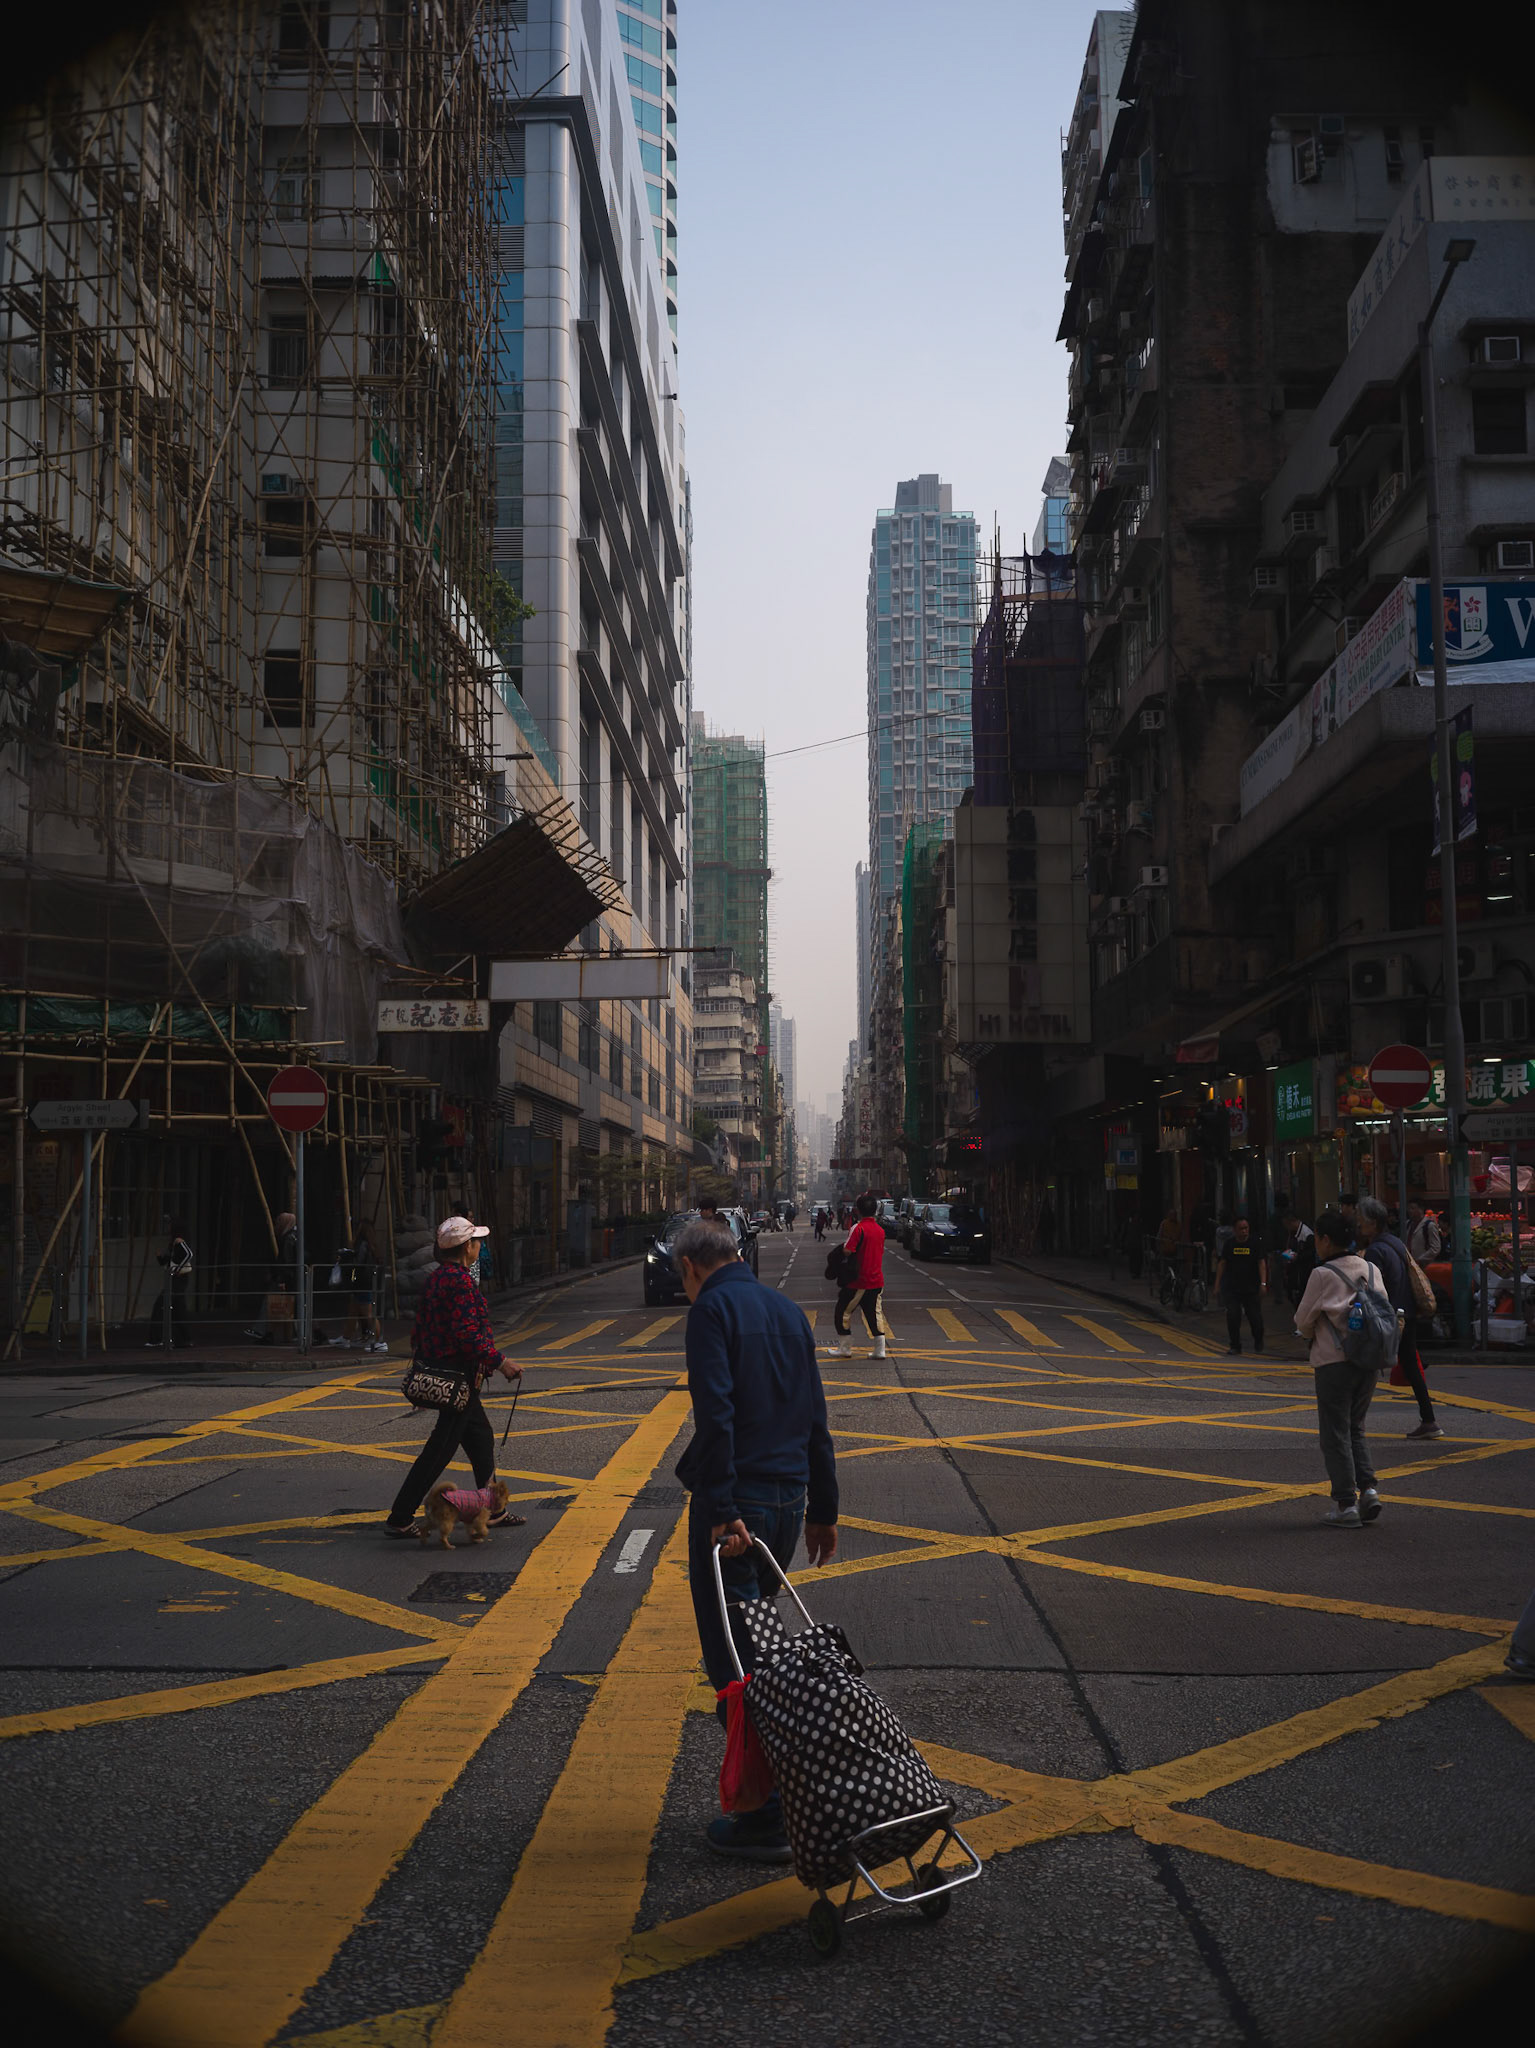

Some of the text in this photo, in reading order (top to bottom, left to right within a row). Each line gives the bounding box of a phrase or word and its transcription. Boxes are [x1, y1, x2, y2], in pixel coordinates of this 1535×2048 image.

[1383, 620, 1405, 658] CENTRE
[979, 1014, 1071, 1033] H1 HOTEL
[57, 1104, 111, 1113] Argyle Street
